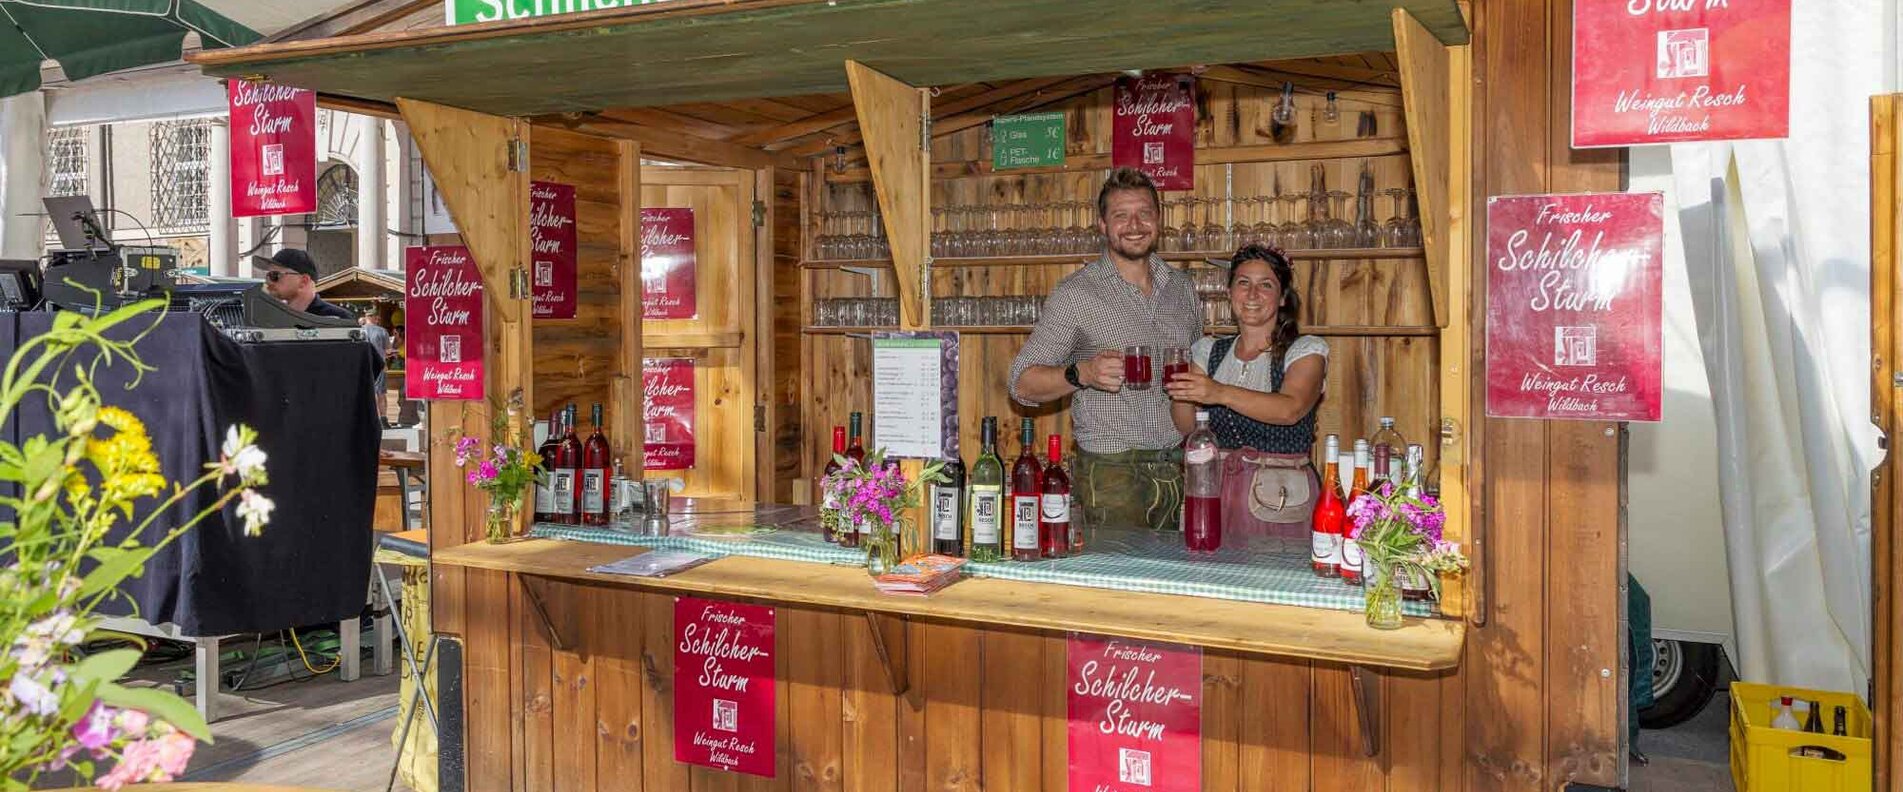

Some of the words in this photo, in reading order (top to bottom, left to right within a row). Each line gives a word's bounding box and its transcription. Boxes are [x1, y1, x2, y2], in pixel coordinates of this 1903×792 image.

[1615, 89, 1685, 116] Weingut
[1687, 85, 1746, 108] Resch
[250, 103, 293, 136] Sturm
[1132, 114, 1173, 137] Sturm
[1647, 115, 1710, 135] Wildbach
[1536, 203, 1614, 226] Frischer
[429, 249, 467, 266] Frischer
[1530, 270, 1615, 313] Sturm
[427, 296, 471, 326] Sturm
[422, 366, 453, 384] Weingut
[453, 367, 476, 380] Resch
[1520, 372, 1579, 398] Weingut
[1579, 373, 1627, 394] Resch
[1547, 396, 1599, 412] Wildbach
[701, 605, 746, 625] Frischer
[679, 623, 769, 663] Schilcher-
[1104, 640, 1162, 663] Frischer
[698, 656, 749, 693] Sturm
[1074, 660, 1193, 706] Schilcher-
[1100, 699, 1166, 742] Sturm
[693, 731, 728, 753] Weingut
[728, 738, 755, 754] Resch
